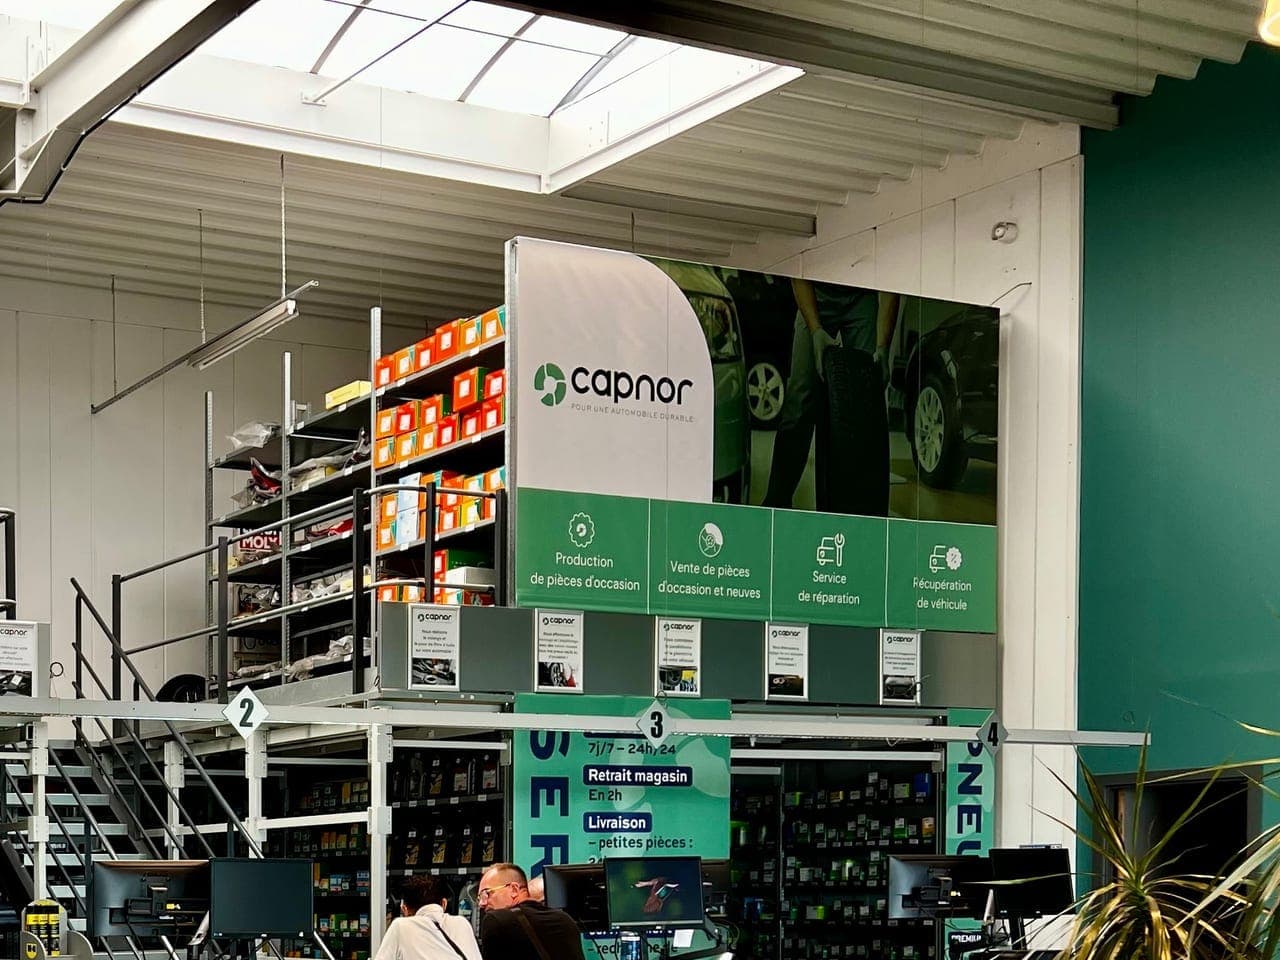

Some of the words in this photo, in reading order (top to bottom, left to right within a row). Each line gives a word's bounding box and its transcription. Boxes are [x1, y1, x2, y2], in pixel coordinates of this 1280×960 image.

[571, 366, 694, 405] capnor
[571, 403, 593, 412] POUR
[594, 405, 609, 414] UNE
[611, 407, 658, 419] AUTOMOBILE
[242, 536, 279, 549] MOLY
[555, 552, 614, 568] Production
[670, 561, 699, 574] Vente
[702, 563, 716, 576] de
[717, 564, 750, 578] pièces
[812, 570, 847, 584] Service
[530, 572, 544, 584] de
[547, 573, 581, 588] pièces
[585, 575, 640, 591] d'occasion
[913, 577, 971, 592] Récupération
[658, 581, 711, 596] d'occasion
[726, 587, 761, 599] neuves
[798, 590, 810, 602] de
[812, 591, 859, 605] réparation
[917, 598, 929, 609] de
[931, 599, 967, 610] véhicule
[424, 612, 452, 622] capnor
[550, 617, 575, 625] capnor
[0, 628, 27, 637] capnor
[670, 623, 694, 631] capnor
[239, 698, 254, 728] 2
[650, 711, 664, 738] 3
[987, 722, 999, 747] 4
[588, 768, 632, 783] Retrait
[634, 770, 688, 786] magasin
[588, 789, 605, 801] En
[607, 789, 622, 801] 2h
[587, 816, 646, 830] Livraison
[599, 836, 643, 850] petites
[645, 836, 686, 850] pièces
